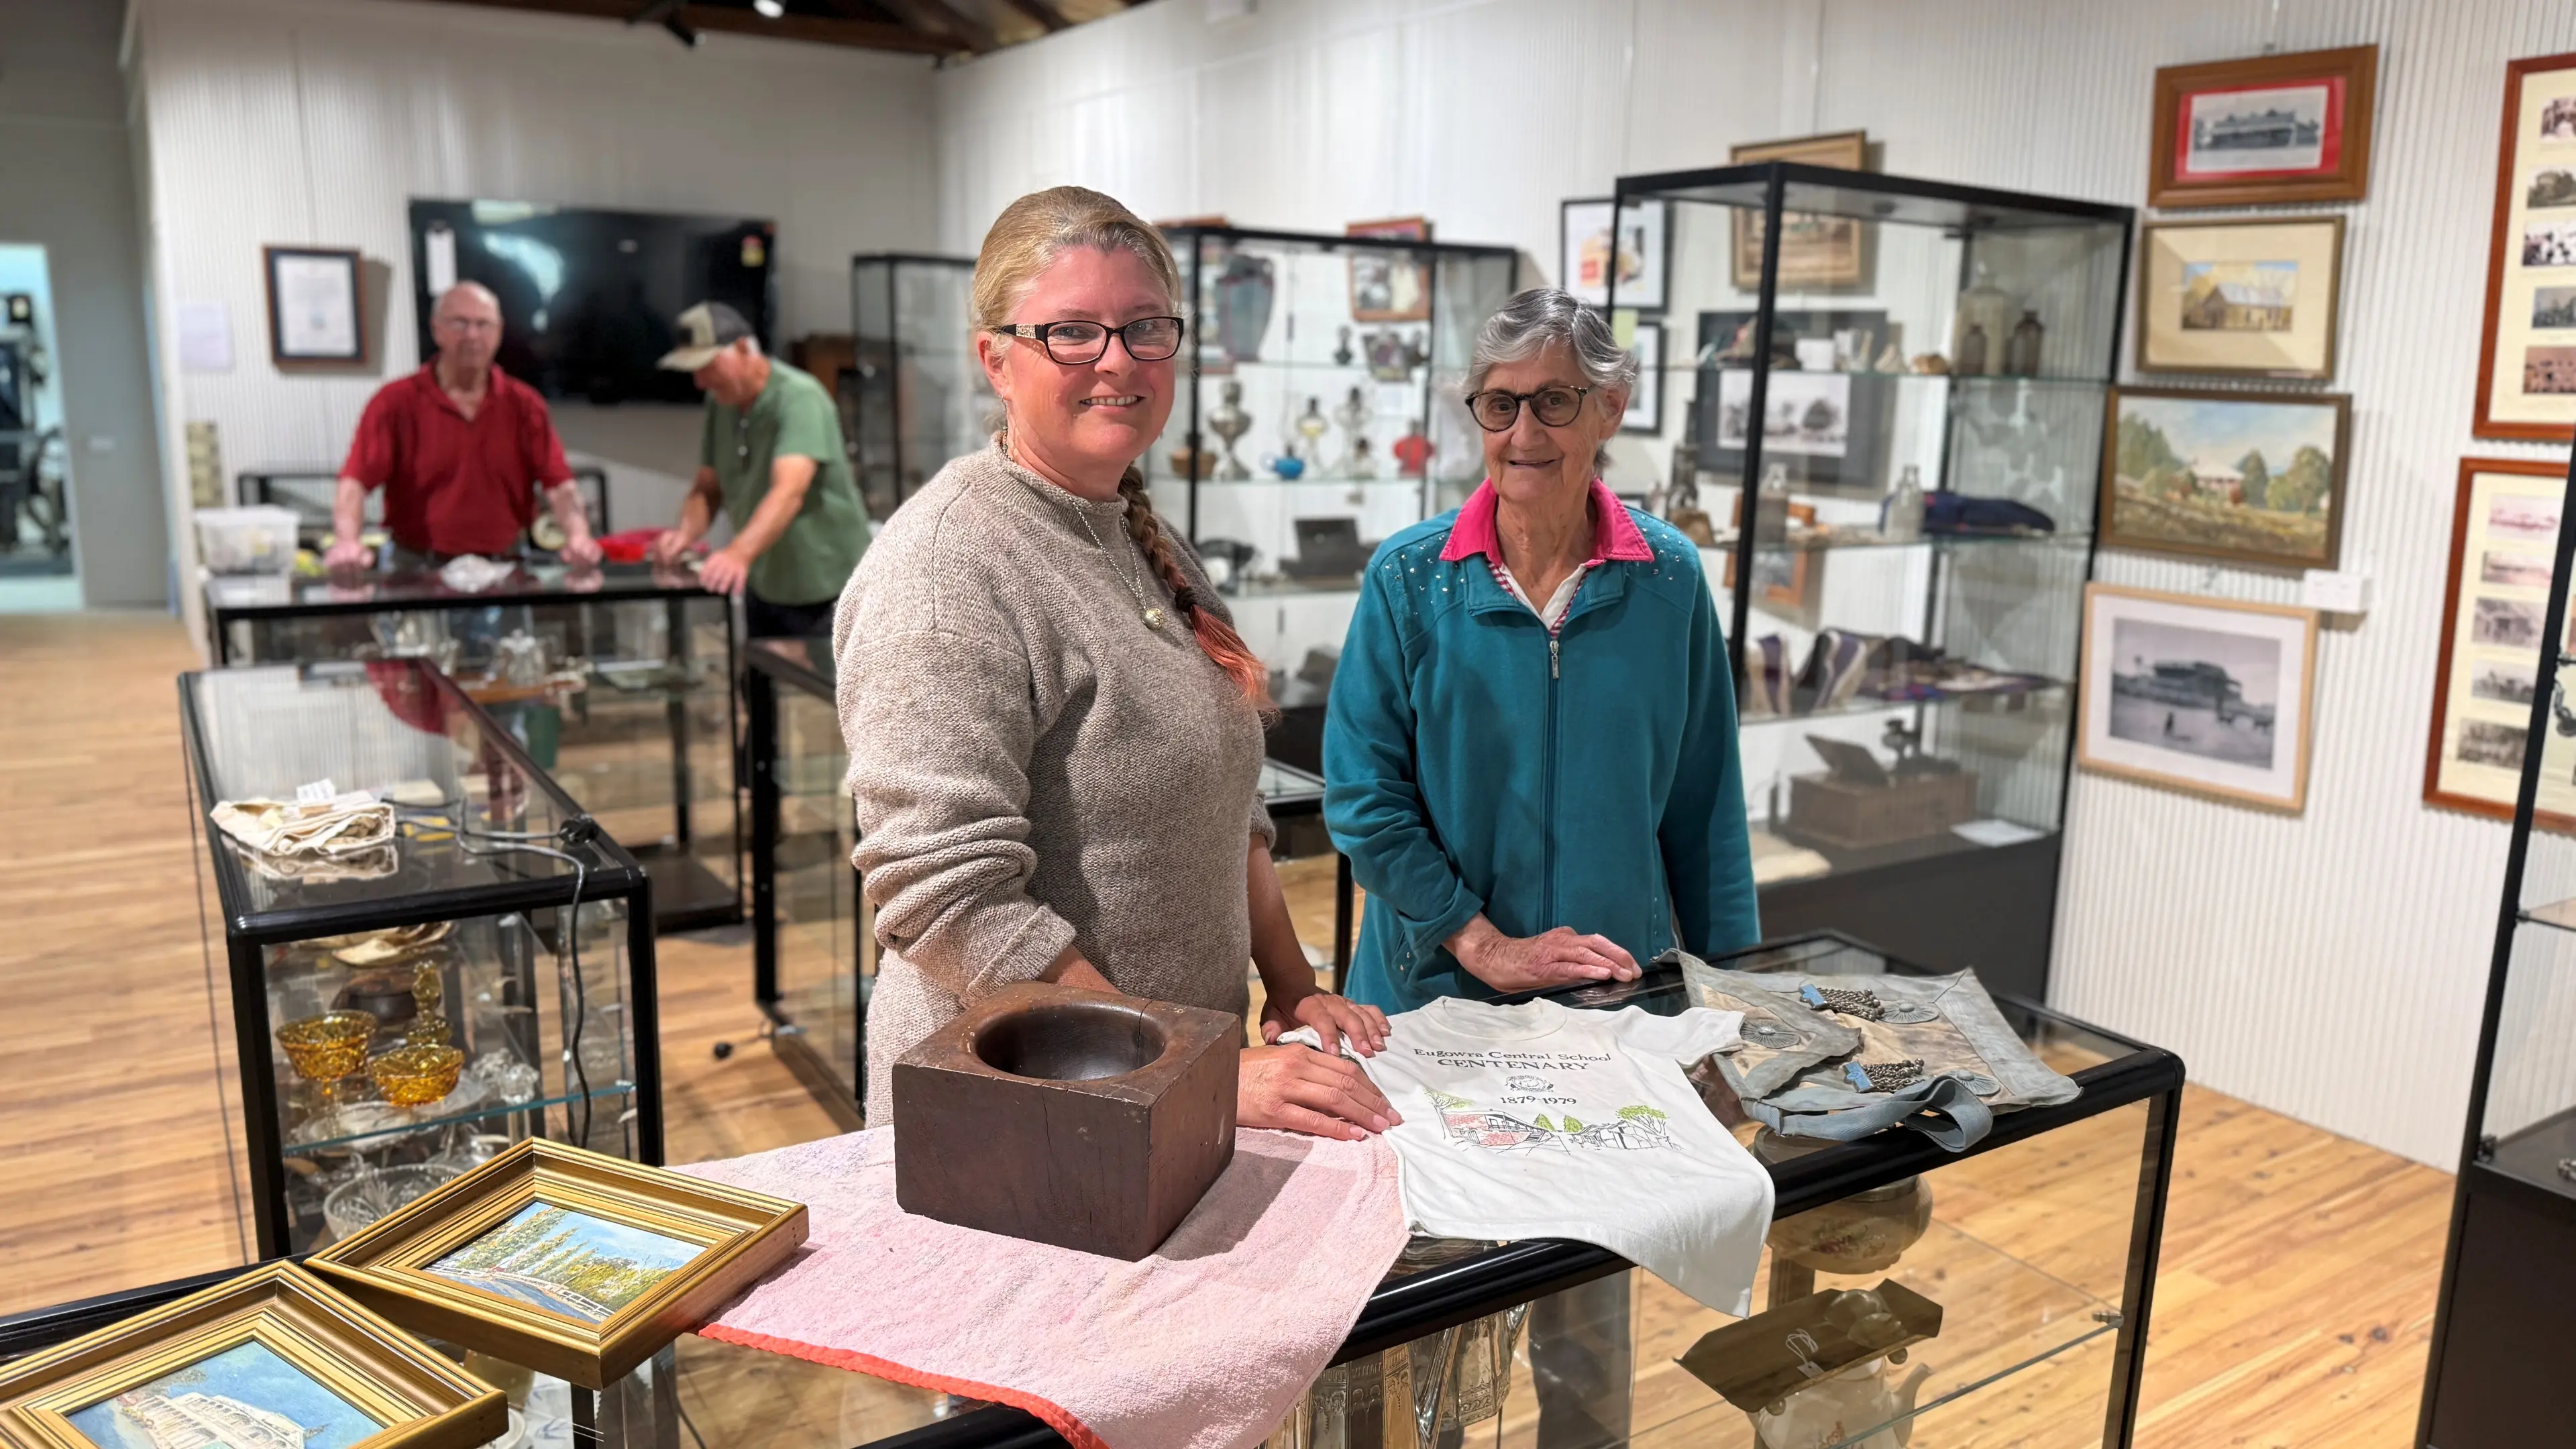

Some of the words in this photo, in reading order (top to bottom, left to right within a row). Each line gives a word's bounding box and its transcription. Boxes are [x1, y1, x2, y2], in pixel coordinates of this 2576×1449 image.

[1413, 1049, 1484, 1058] Eugowra
[1489, 1051, 1552, 1060] Central
[1558, 1053, 1611, 1061] School
[1437, 1059, 1589, 1071] CENTENARY
